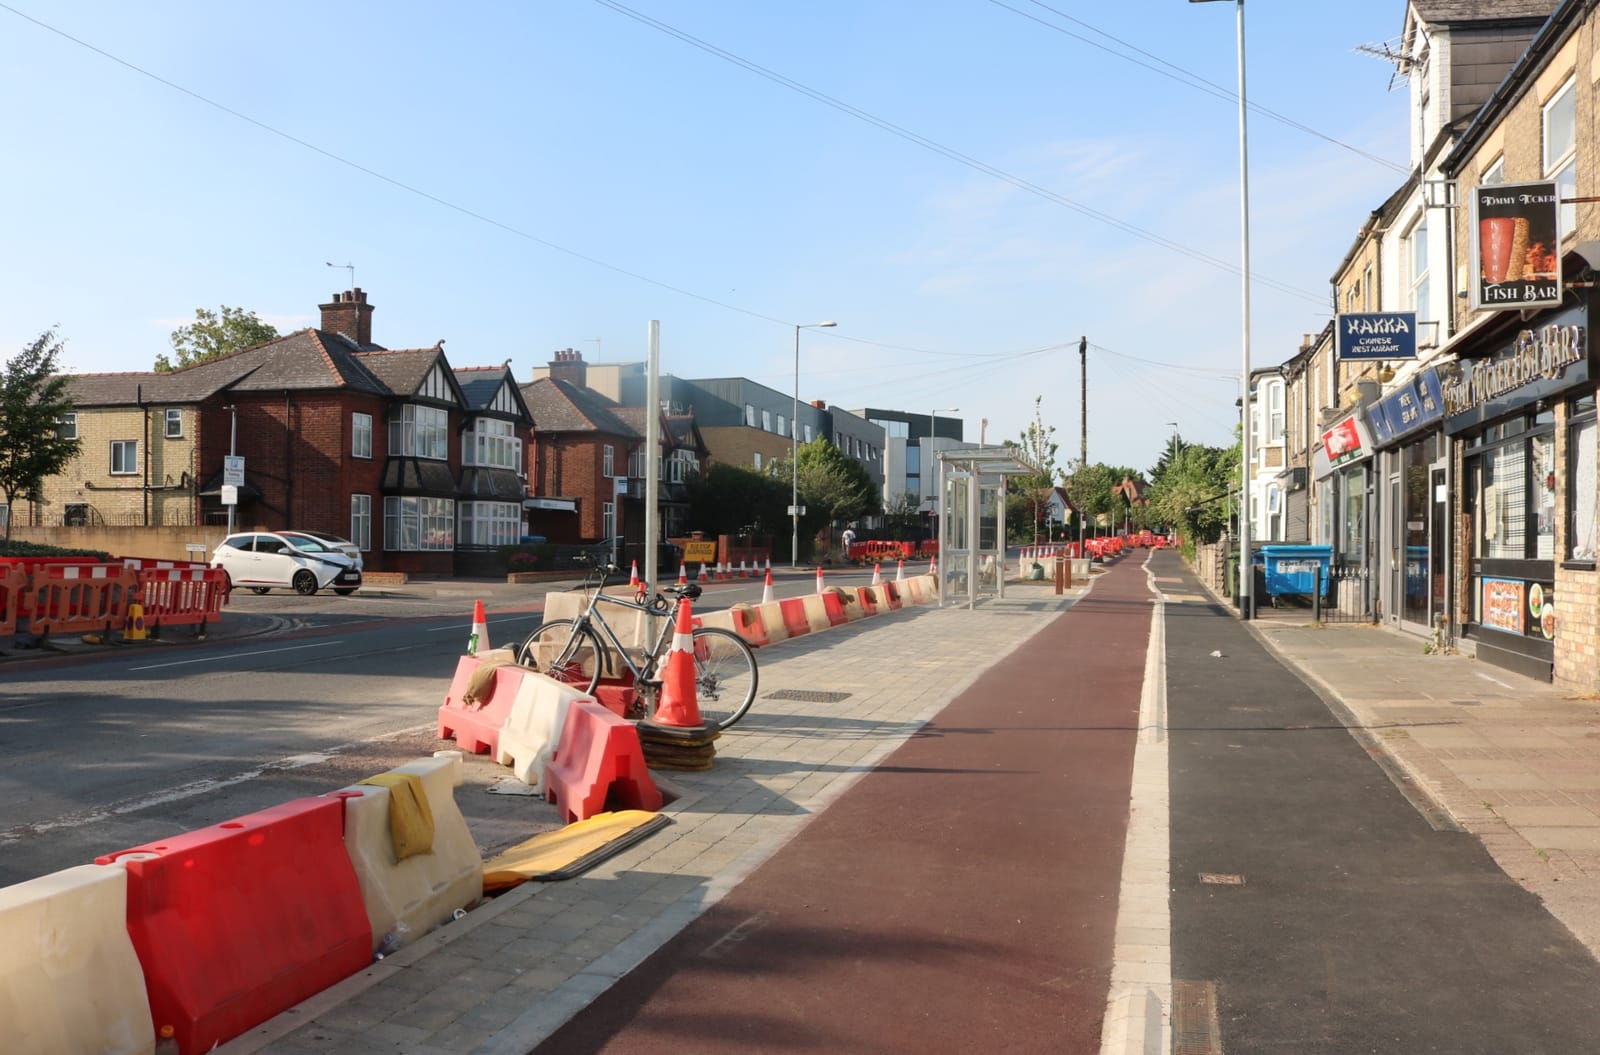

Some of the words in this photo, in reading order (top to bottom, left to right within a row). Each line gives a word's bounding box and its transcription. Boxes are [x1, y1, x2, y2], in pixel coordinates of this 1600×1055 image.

[1481, 195, 1515, 207] TOMMY
[1483, 283, 1517, 301] FISH
[1523, 284, 1557, 302] BAR
[1347, 317, 1409, 335] HAKKA
[1352, 345, 1400, 353] RESTAURANT
[1471, 357, 1512, 407] TUCKER
[1513, 329, 1541, 385] FISH
[1541, 324, 1581, 380] BAR
